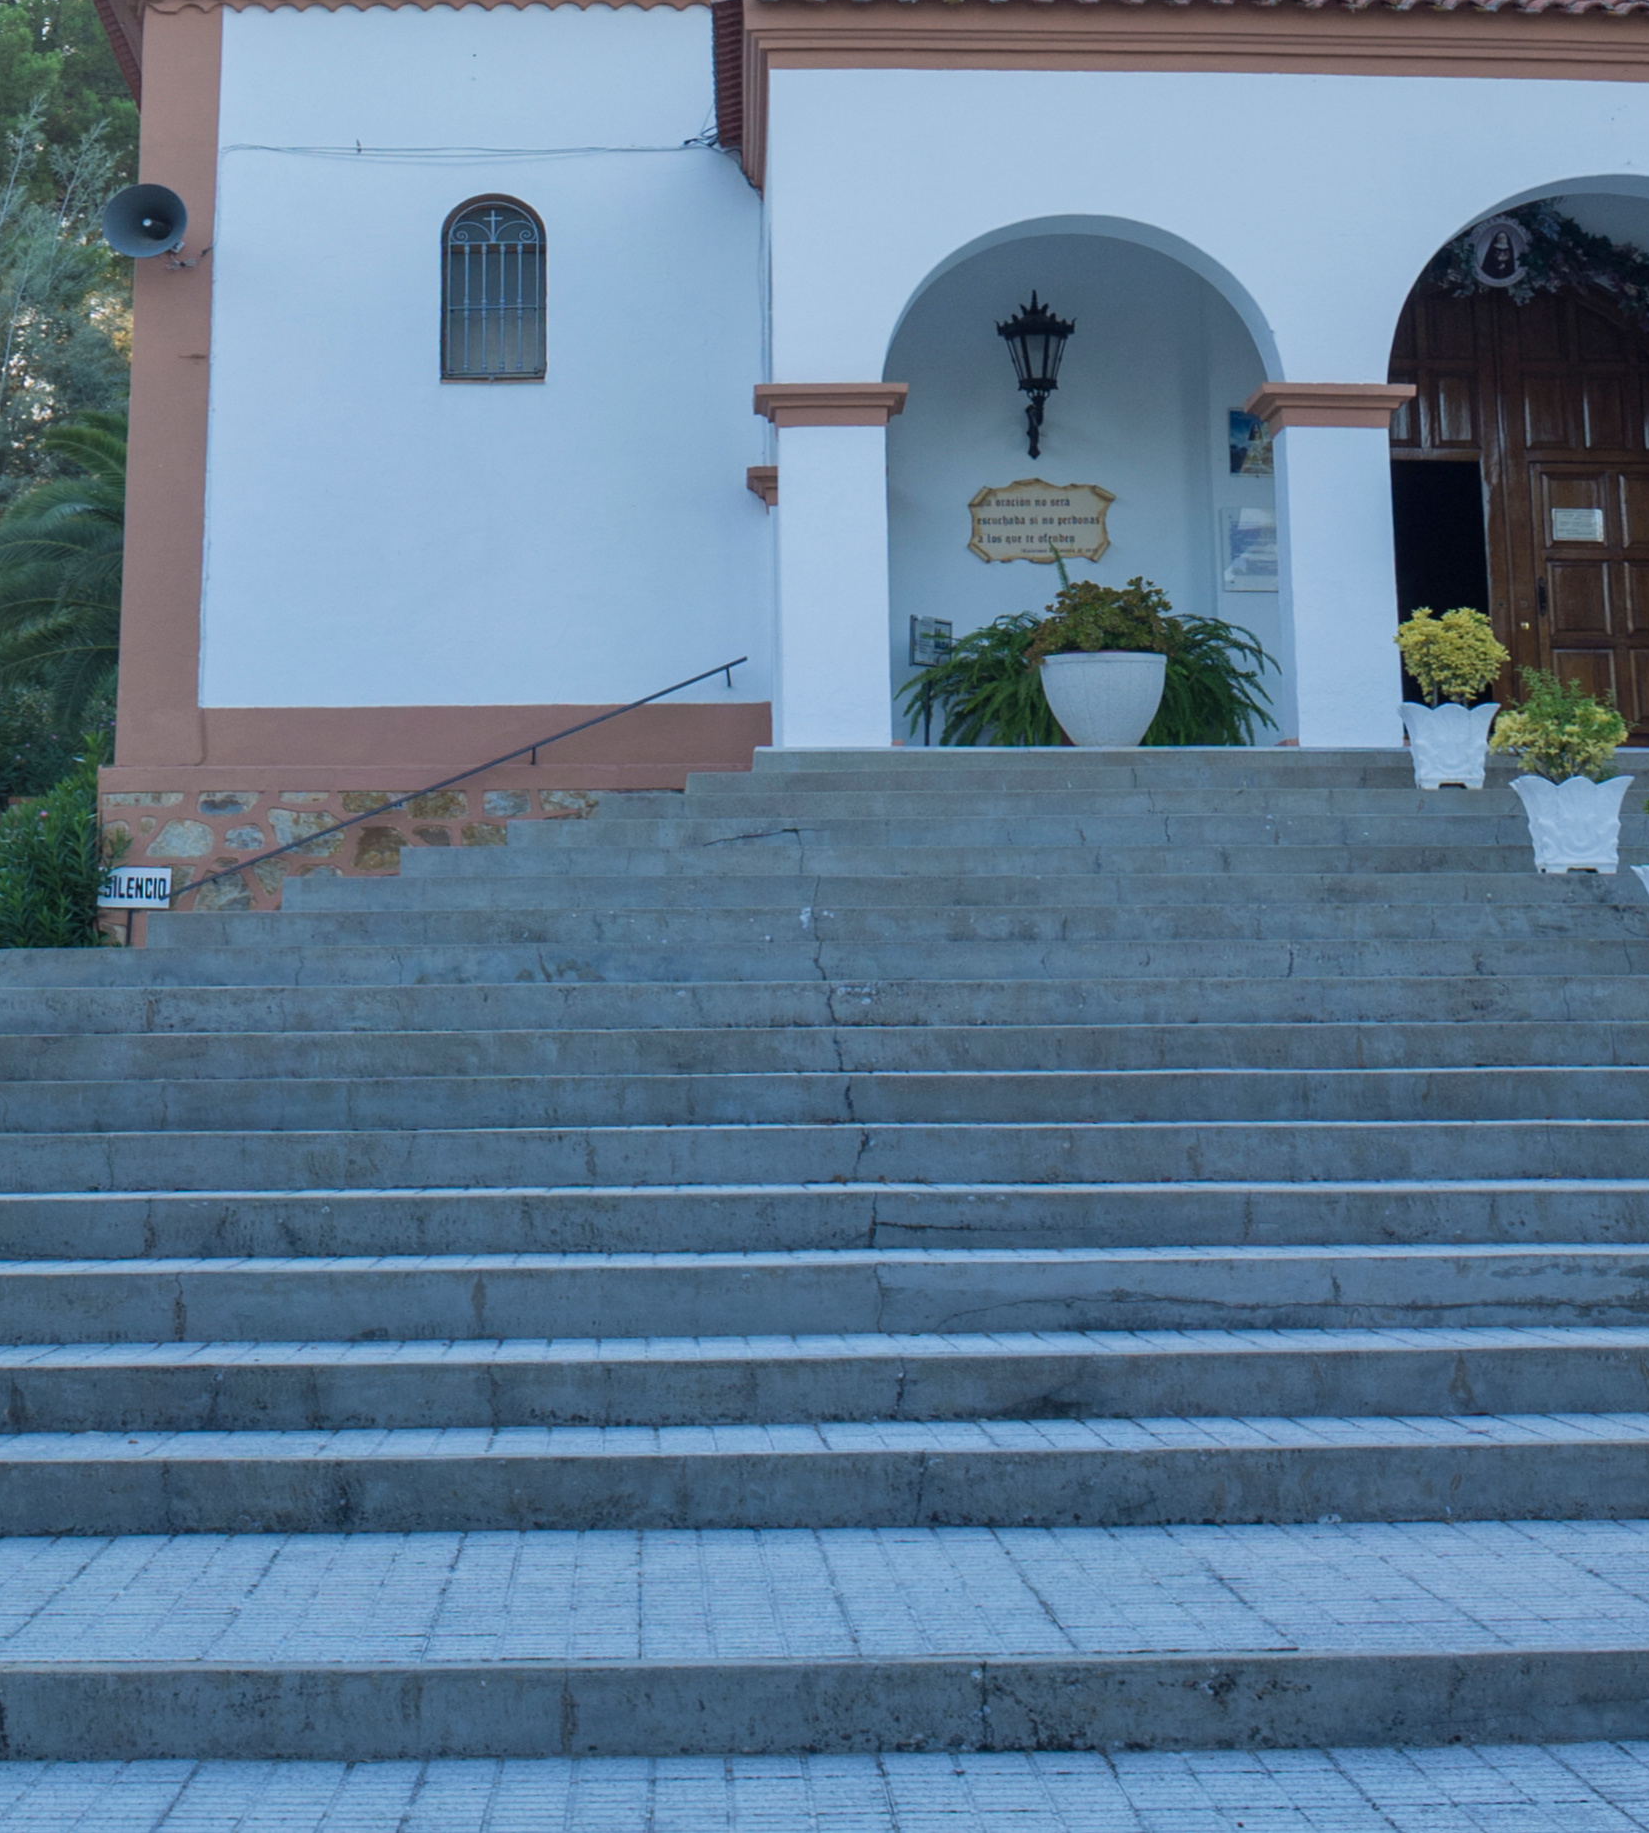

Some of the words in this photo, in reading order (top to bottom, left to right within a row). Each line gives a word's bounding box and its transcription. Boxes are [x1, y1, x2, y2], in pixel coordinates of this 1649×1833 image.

[995, 498, 1031, 507] oración
[1035, 499, 1047, 507] no
[977, 515, 1026, 526] escuchada
[1042, 516, 1054, 525] no
[1058, 515, 1100, 526] perdonas
[987, 534, 1002, 544] los
[1005, 535, 1022, 545] que
[104, 876, 167, 899] SILENCIO
